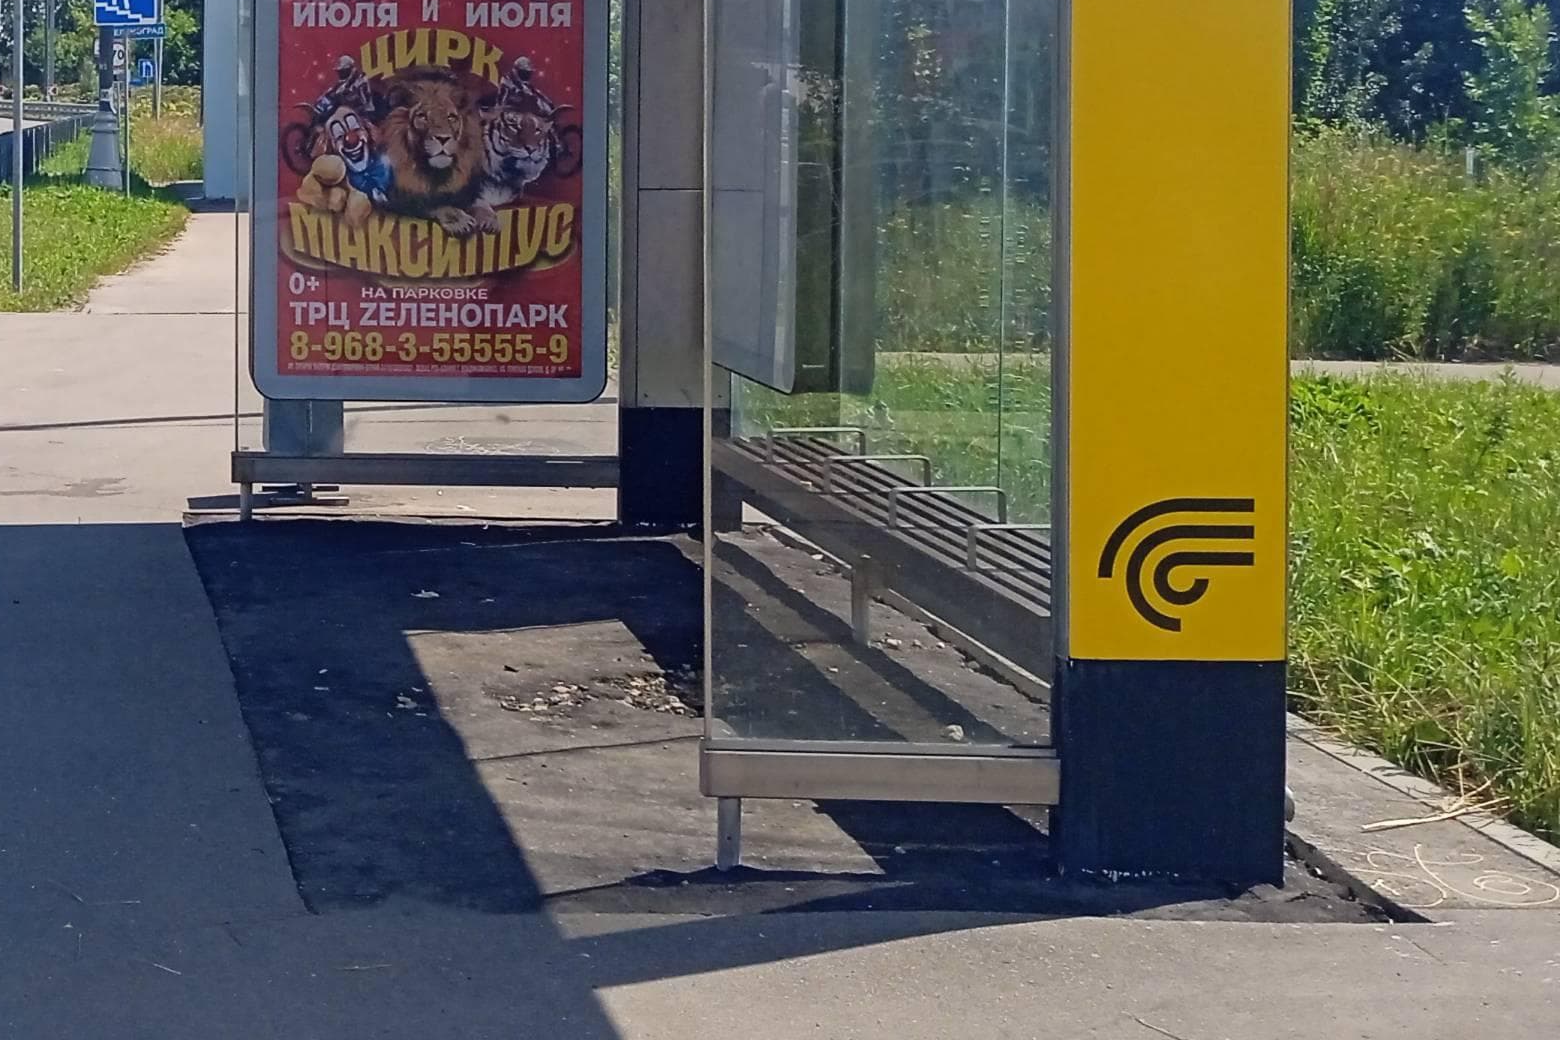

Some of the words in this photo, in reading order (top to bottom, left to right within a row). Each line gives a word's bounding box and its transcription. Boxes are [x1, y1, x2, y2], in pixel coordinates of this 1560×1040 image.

[293, 2, 398, 28] ИЮЛЯ
[465, 2, 572, 28] ИЮЛЯ
[360, 28, 504, 88] ЦИРК
[288, 202, 575, 278] МАКСИМУС
[288, 272, 320, 295] 0+
[361, 287, 387, 299] НА
[392, 287, 489, 300] ПАРКОВКЕ
[290, 302, 350, 331] ТРЦ
[290, 331, 569, 364] 8-968-3-55555-9
